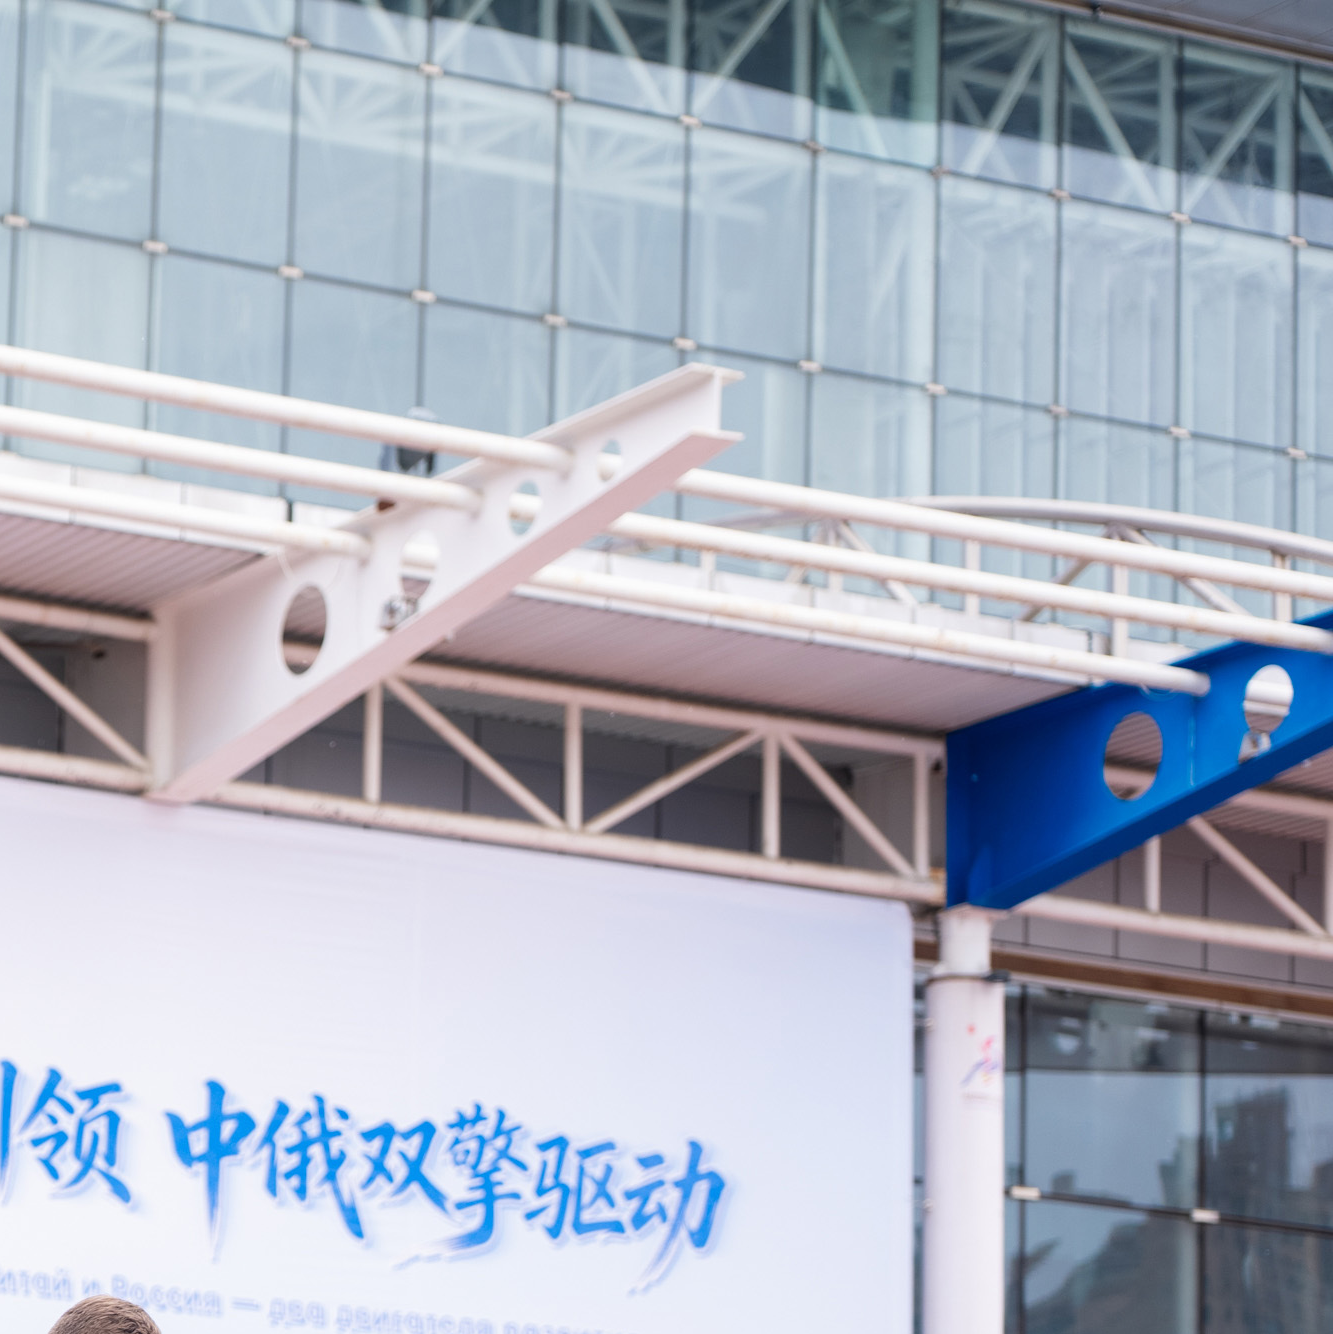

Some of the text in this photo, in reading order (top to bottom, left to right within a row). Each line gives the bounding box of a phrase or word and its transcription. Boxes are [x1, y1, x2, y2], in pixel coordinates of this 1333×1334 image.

[163, 1078, 729, 1288] 中俄双擎驱动
[111, 1272, 223, 1317] Россия
[268, 1296, 326, 1330] два
